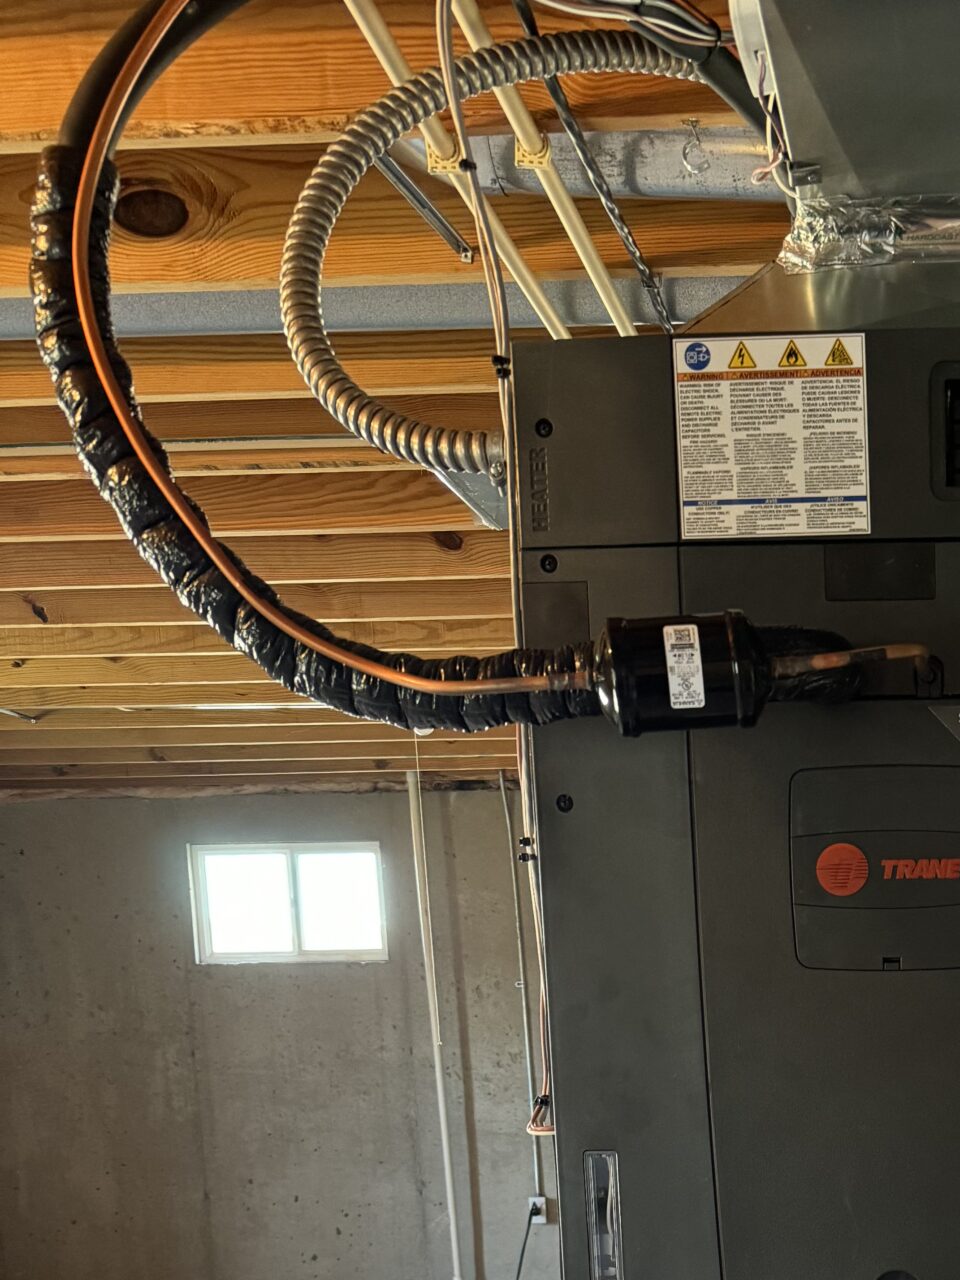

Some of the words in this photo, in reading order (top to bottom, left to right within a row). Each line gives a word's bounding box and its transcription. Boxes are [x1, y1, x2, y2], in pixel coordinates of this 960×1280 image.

[740, 370, 799, 379] AVERTISSEMENT
[811, 369, 861, 377] ADVERTENCIA
[529, 447, 549, 532] HEATER
